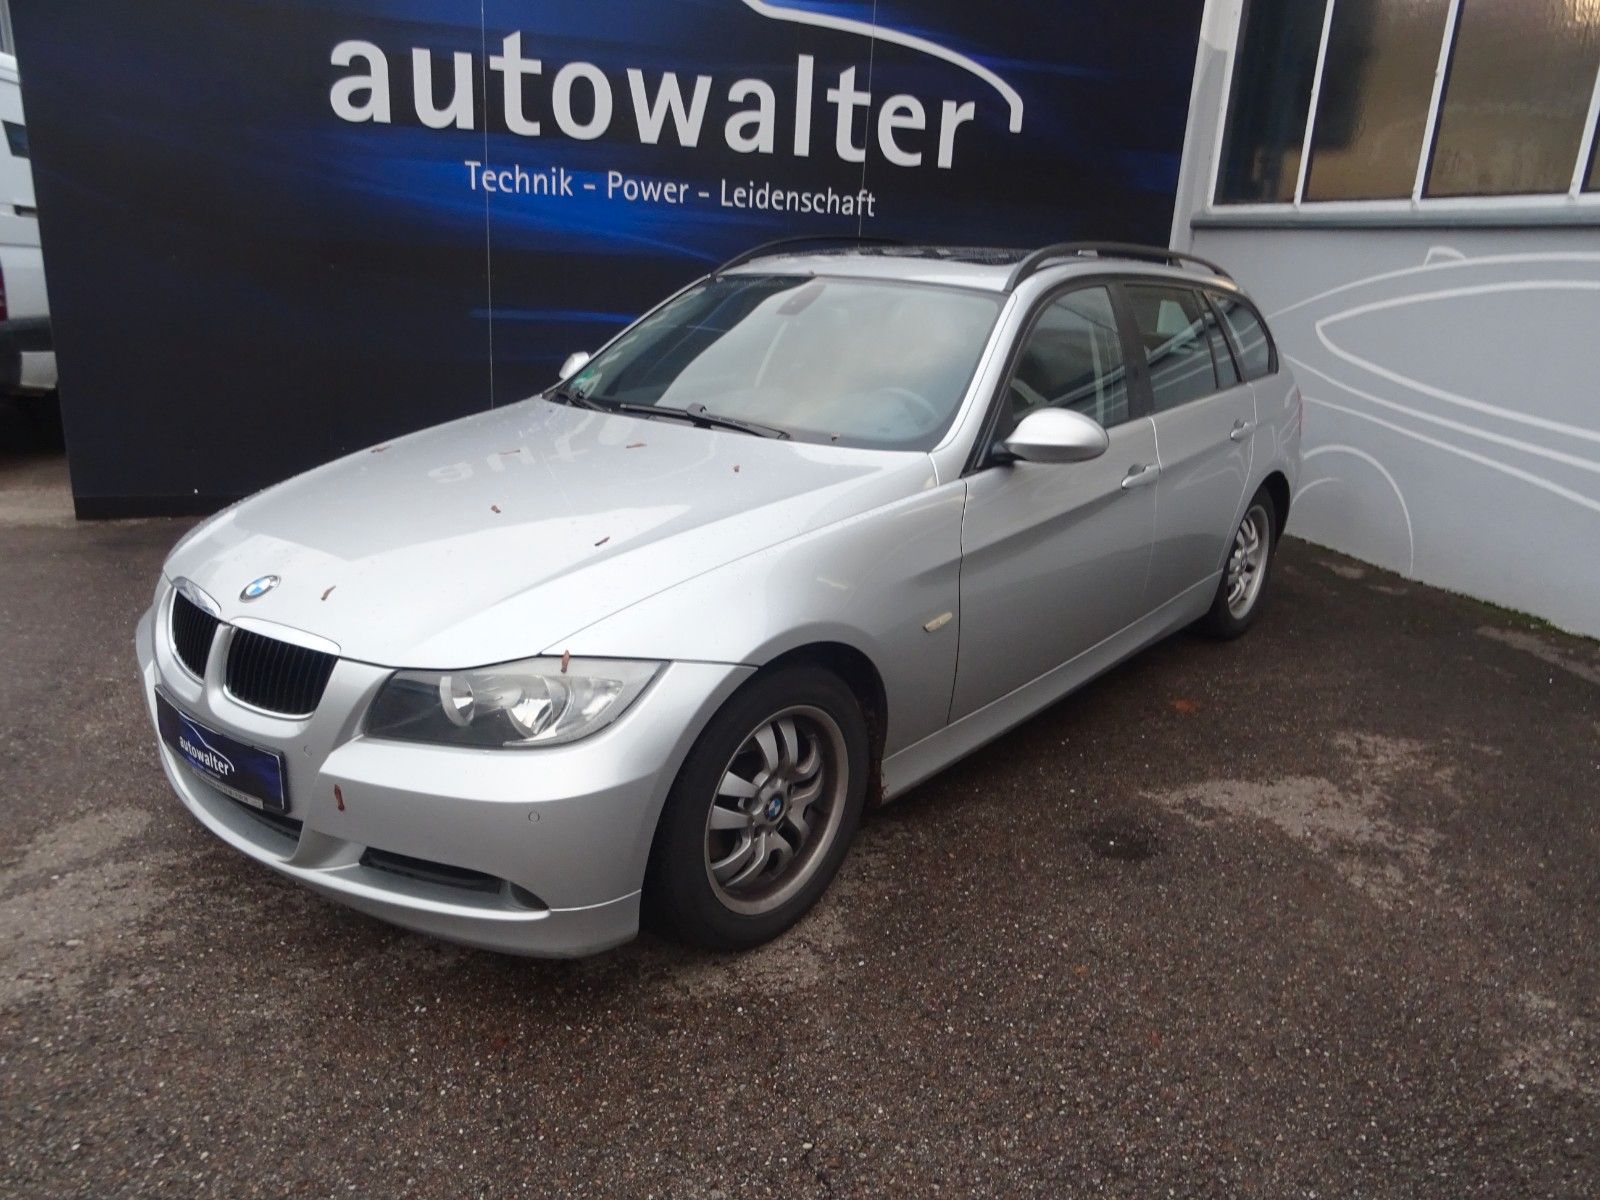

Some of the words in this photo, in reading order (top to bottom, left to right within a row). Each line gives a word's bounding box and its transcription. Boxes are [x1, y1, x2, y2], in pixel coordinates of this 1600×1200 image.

[329, 30, 976, 169] autowalter
[464, 160, 574, 197] Technik
[607, 170, 690, 205] Power
[721, 178, 876, 217] Leidenschaft
[179, 735, 230, 776] autowalter
